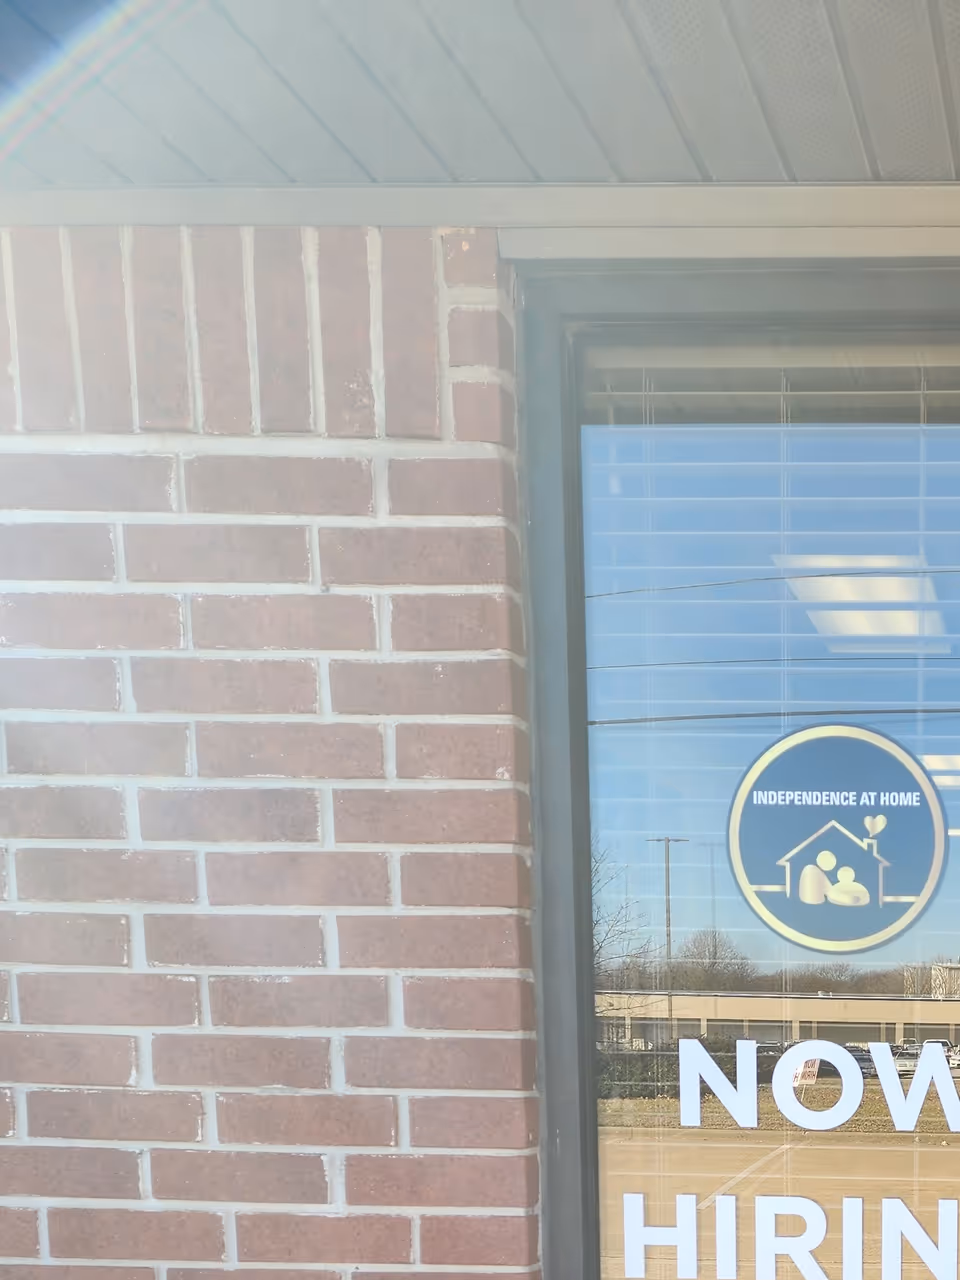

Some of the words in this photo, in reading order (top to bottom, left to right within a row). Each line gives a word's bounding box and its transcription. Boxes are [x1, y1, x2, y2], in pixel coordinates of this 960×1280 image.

[753, 790, 857, 805] INDEPENDENCE
[859, 791, 877, 806] AT
[879, 791, 921, 806] HOME
